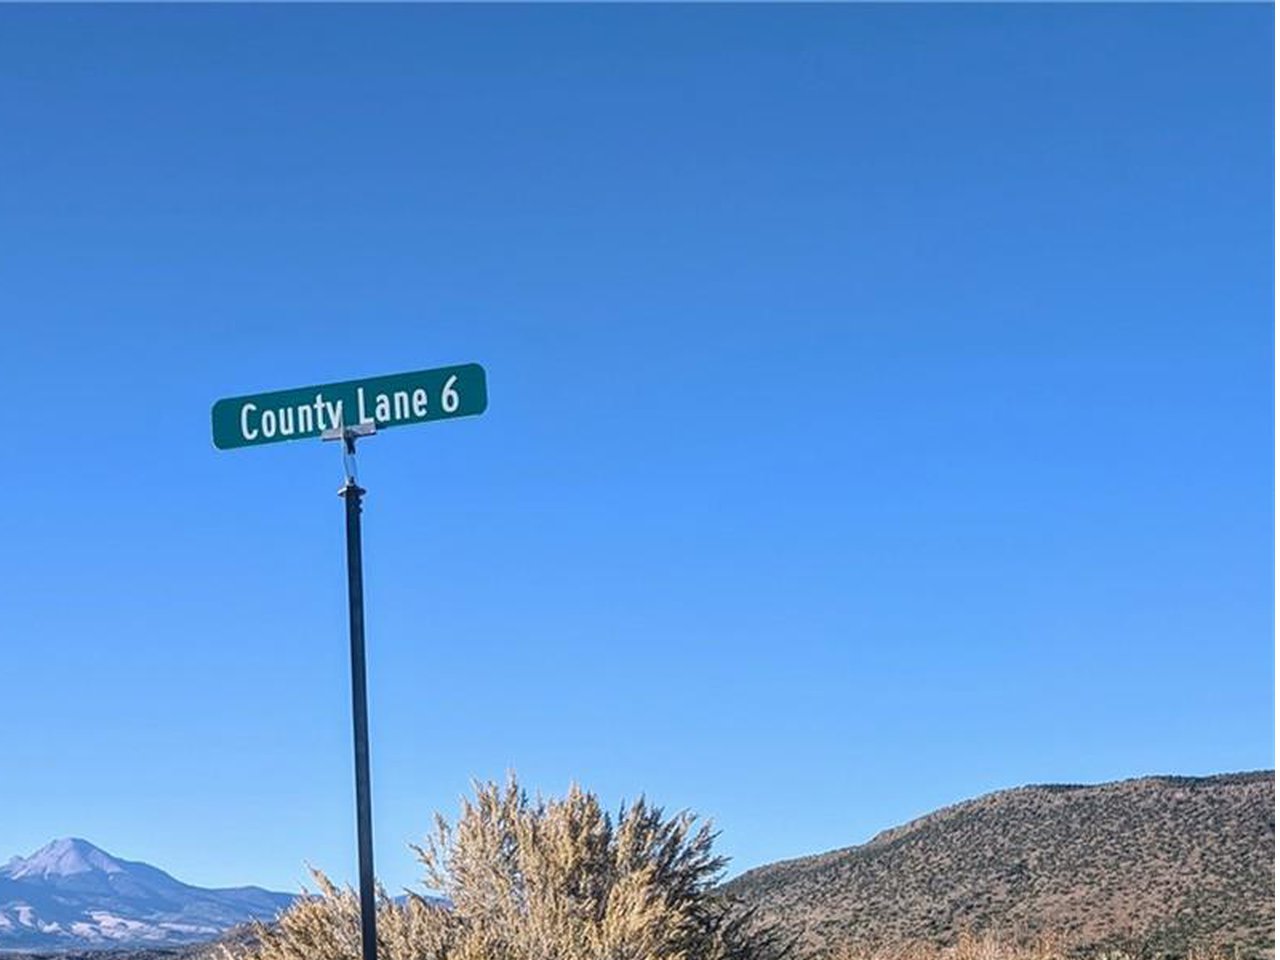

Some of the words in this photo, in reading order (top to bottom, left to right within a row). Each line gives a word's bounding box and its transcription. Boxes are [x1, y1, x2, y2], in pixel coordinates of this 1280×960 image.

[240, 394, 343, 440] County
[357, 387, 428, 425] Lane
[441, 375, 460, 413] 6
